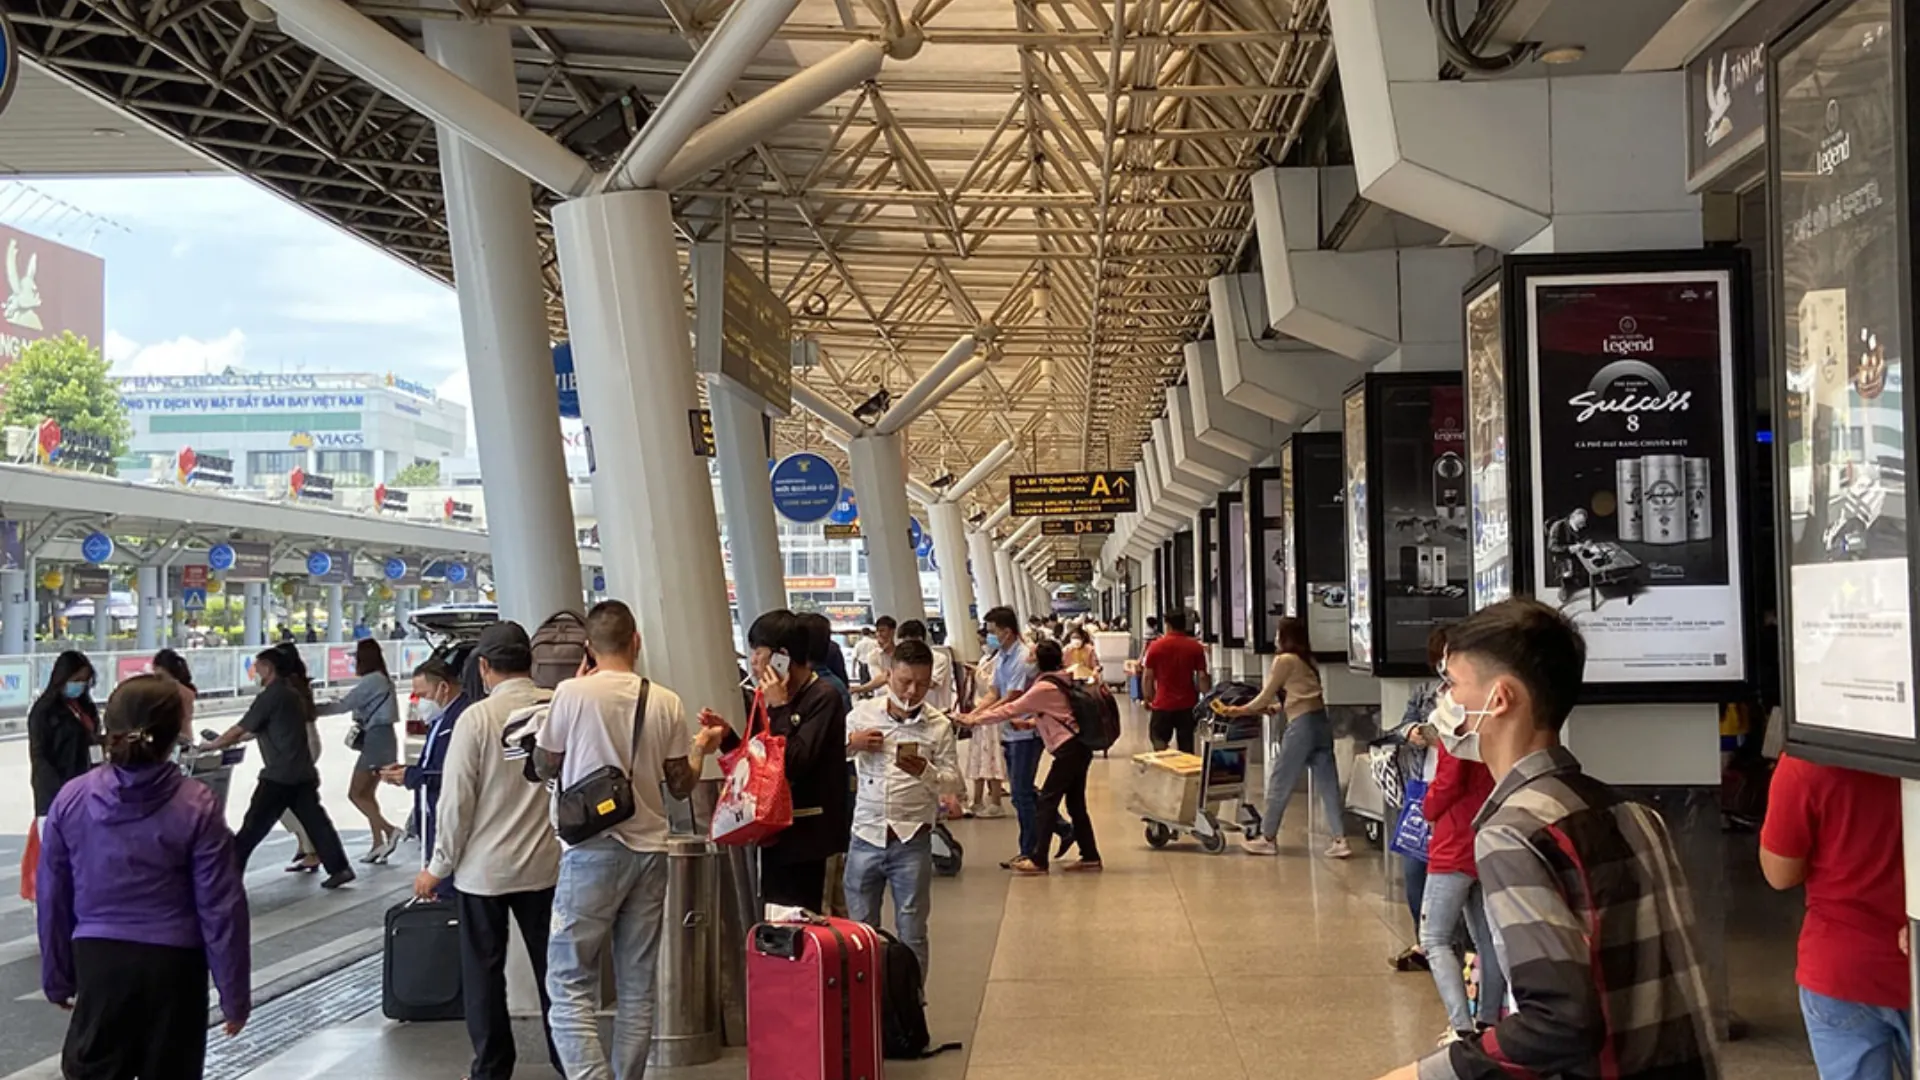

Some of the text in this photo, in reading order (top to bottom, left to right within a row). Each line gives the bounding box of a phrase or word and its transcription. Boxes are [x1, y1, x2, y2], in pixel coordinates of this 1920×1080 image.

[1731, 54, 1750, 88] TÂN
[1817, 132, 1849, 175] Legend
[1603, 337, 1653, 354] Legend
[278, 374, 316, 387] NAM
[340, 396, 364, 406] NAM
[1568, 391, 1692, 422] Success
[1627, 414, 1640, 432] 8
[315, 433, 364, 445] VIAGS
[1039, 477, 1066, 485] TRONG
[1091, 474, 1111, 496] A
[1074, 520, 1093, 533] D4
